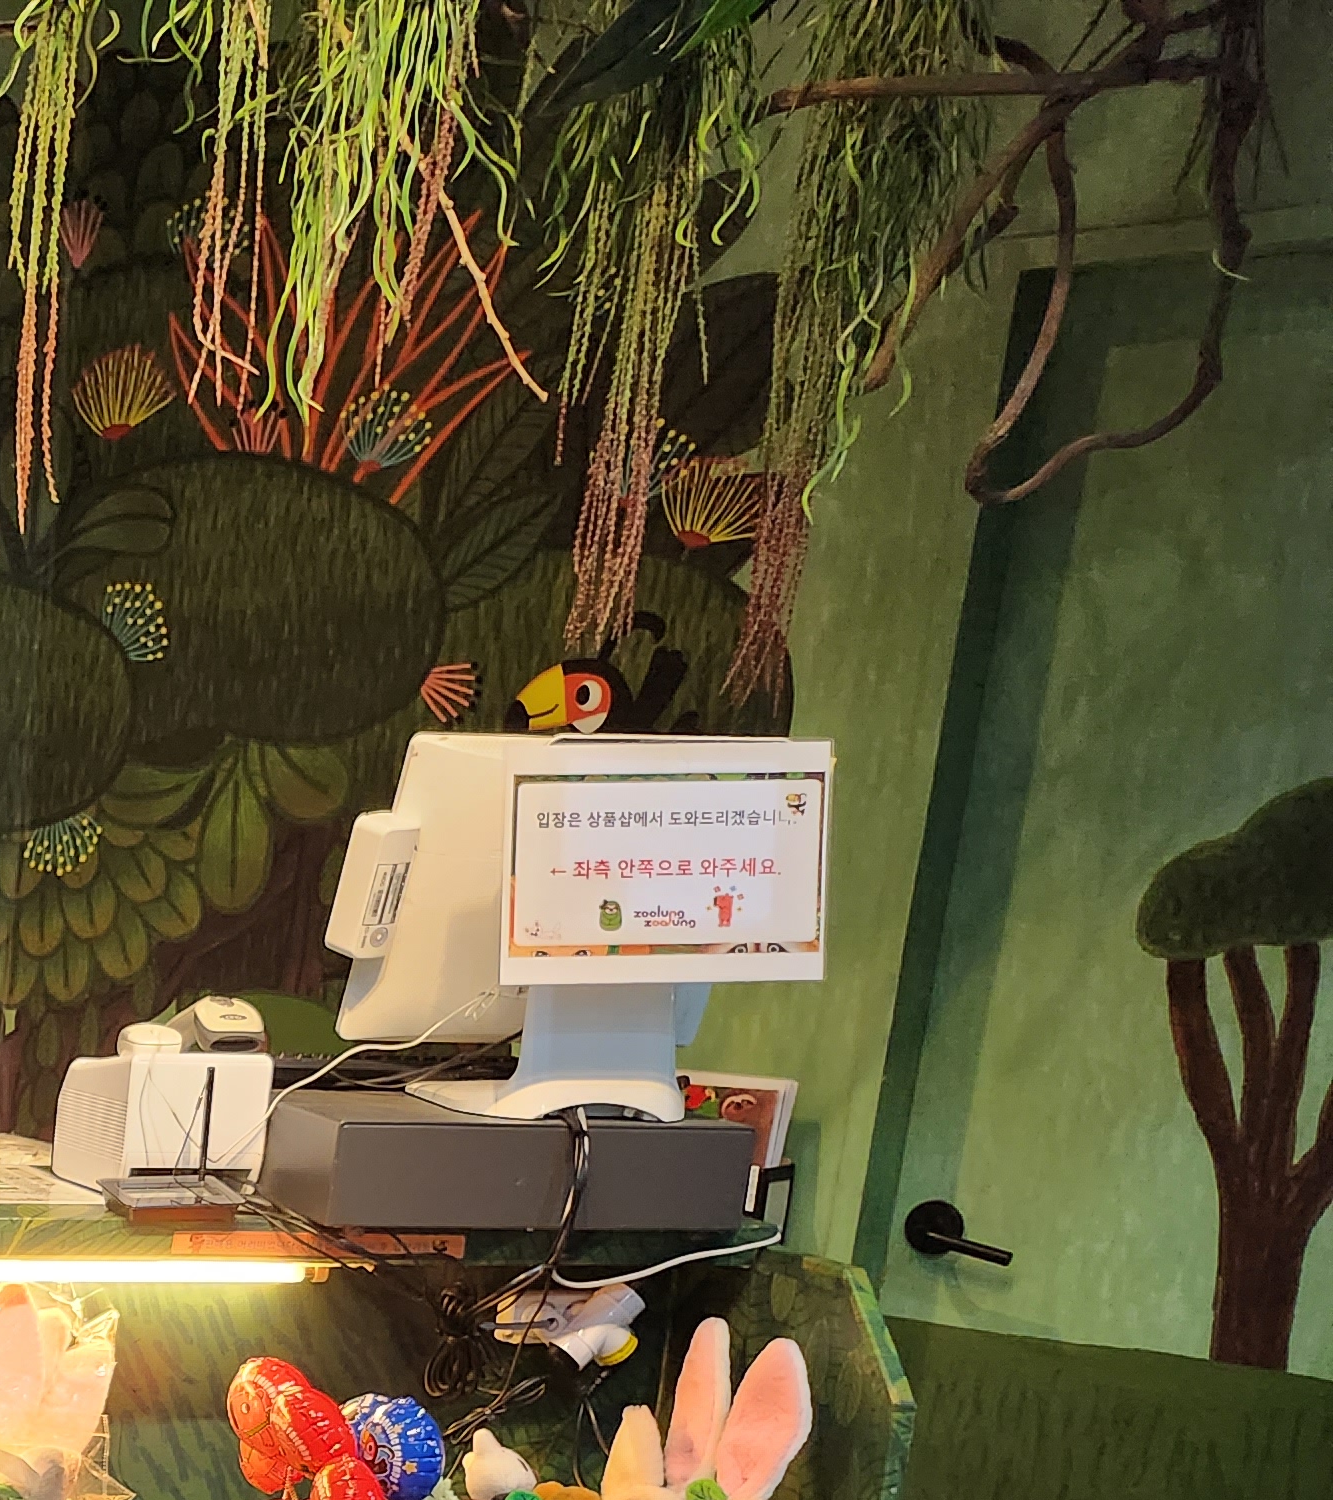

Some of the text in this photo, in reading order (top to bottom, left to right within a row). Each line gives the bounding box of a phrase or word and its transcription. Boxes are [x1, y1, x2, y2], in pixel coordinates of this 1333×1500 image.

[537, 812, 582, 828] 입장은
[586, 812, 663, 828] 상품샵에서
[573, 858, 781, 879] 좌측 안쪽으로 와주세요.
[634, 906, 684, 919] zoolung
[644, 917, 696, 928] zoolung
